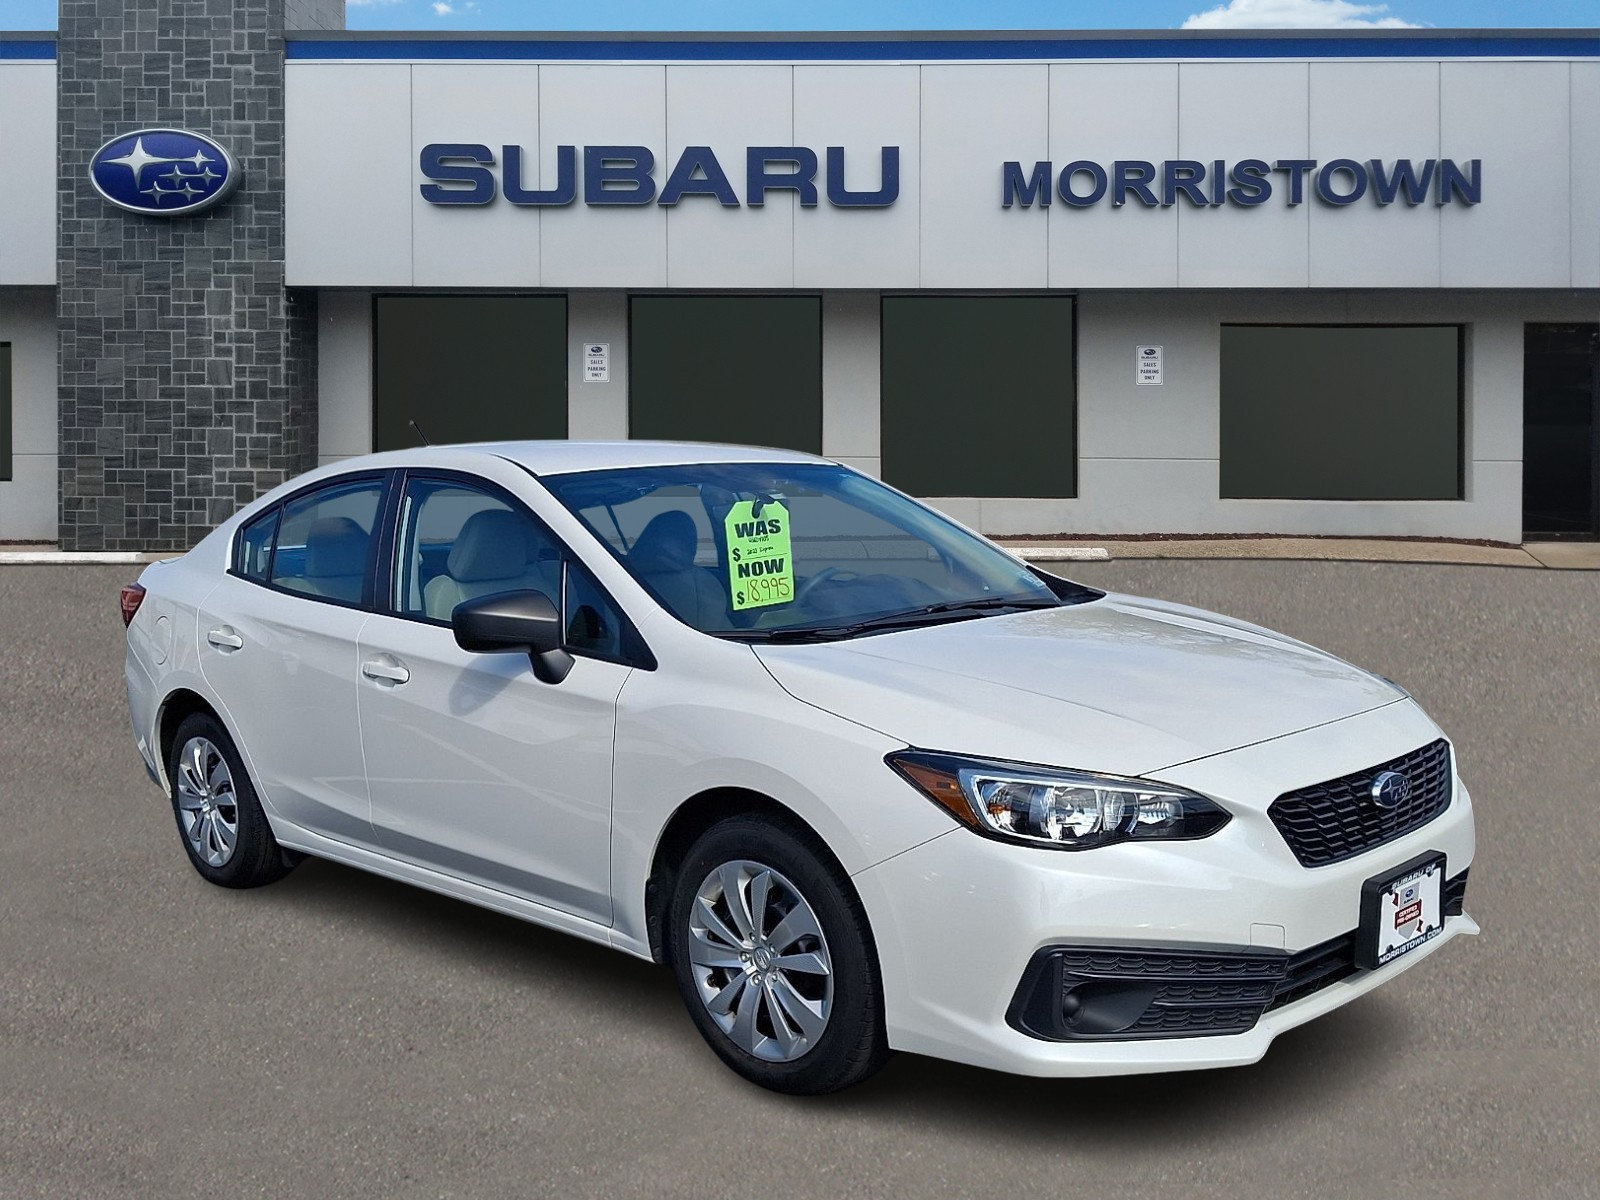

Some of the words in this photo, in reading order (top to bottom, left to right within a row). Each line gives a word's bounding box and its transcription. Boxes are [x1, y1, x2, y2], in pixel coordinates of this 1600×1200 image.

[420, 144, 900, 208] SUBARU
[1003, 157, 1482, 211] MORRISTOWN
[734, 519, 781, 538] WAS
[733, 547, 741, 562] $
[737, 558, 784, 578] NOW
[736, 591, 745, 605] $
[1391, 869, 1424, 891] SUBARU
[1425, 863, 1436, 875] OF
[1379, 926, 1443, 964] MORRISTOWN.COM
